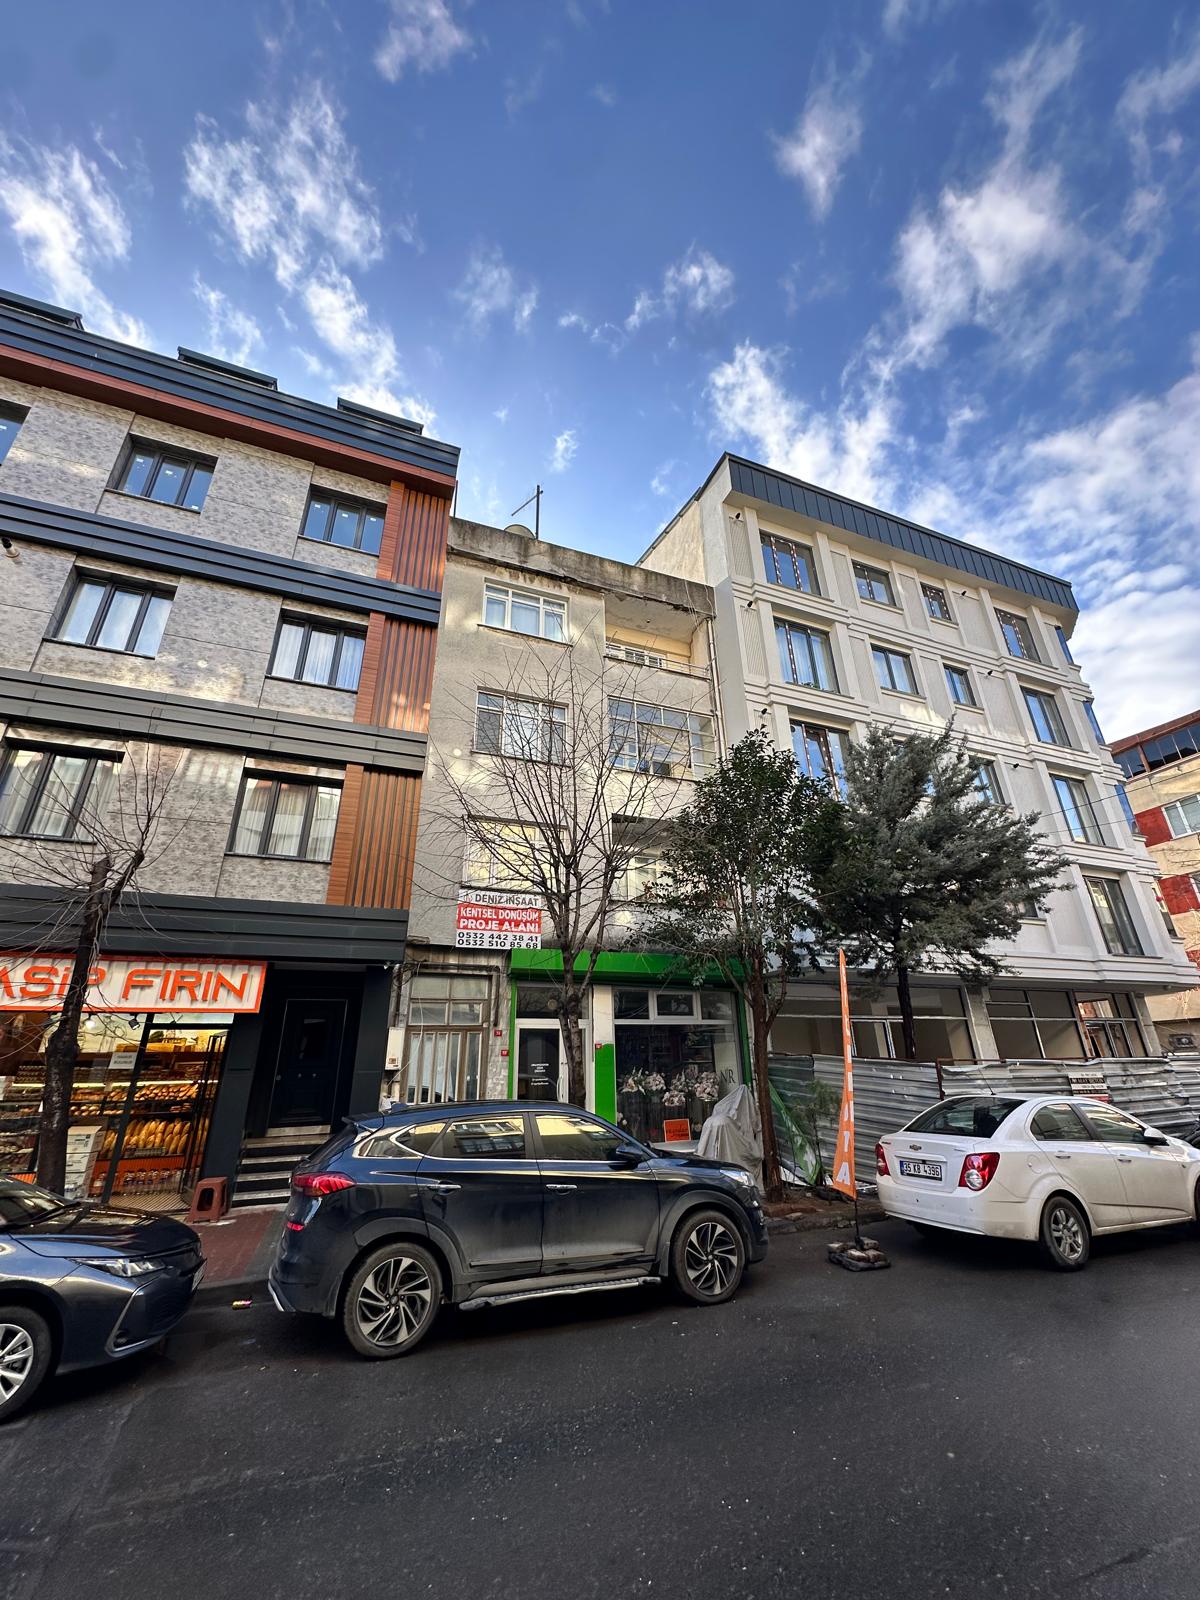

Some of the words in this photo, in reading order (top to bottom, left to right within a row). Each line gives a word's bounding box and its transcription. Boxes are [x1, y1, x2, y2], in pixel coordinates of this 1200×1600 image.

[460, 906, 498, 919] KENTSEL
[459, 918, 500, 931] PROJE
[501, 920, 539, 933] ALANI
[457, 931, 485, 940] 0532
[488, 933, 509, 941] 442
[511, 934, 525, 942] 38
[457, 938, 485, 947] 0532
[488, 940, 506, 948] 510
[509, 941, 522, 949] 85
[525, 942, 538, 950] 68
[121, 968, 249, 1002] FIRIN
[903, 1162, 912, 1173] 35
